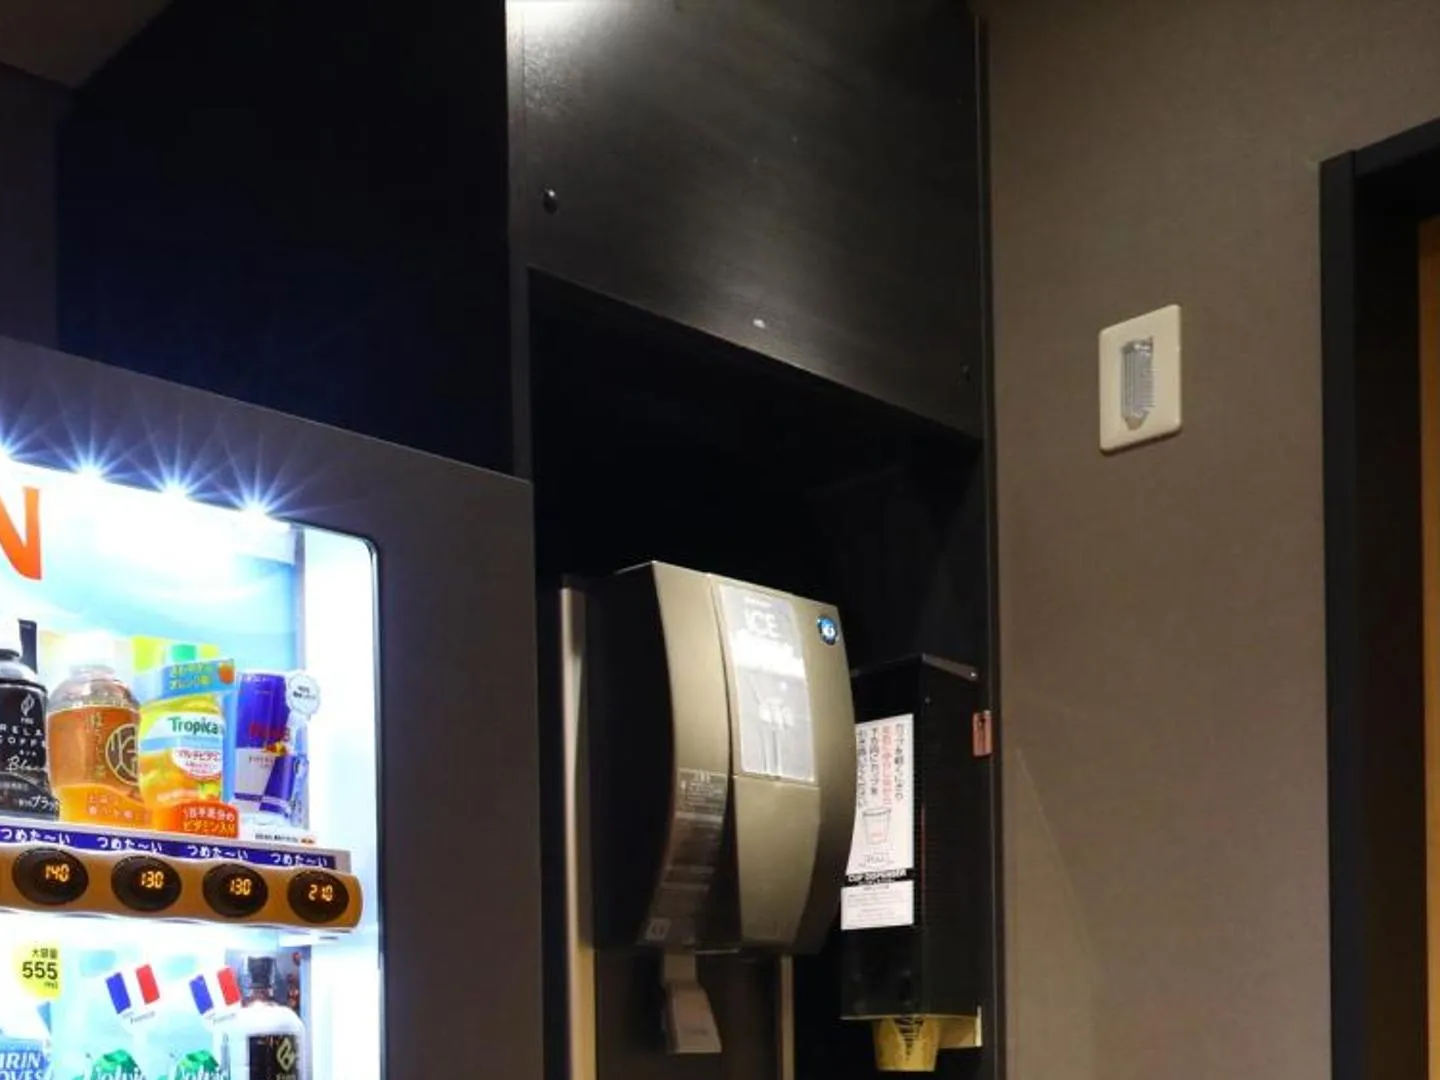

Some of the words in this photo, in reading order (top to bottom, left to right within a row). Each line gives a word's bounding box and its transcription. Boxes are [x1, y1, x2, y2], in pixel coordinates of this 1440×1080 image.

[745, 611, 779, 638] ICE
[45, 864, 70, 882] 140
[141, 872, 164, 889] 130
[229, 878, 251, 895] 130
[308, 884, 334, 901] 210
[22, 962, 58, 979] 555
